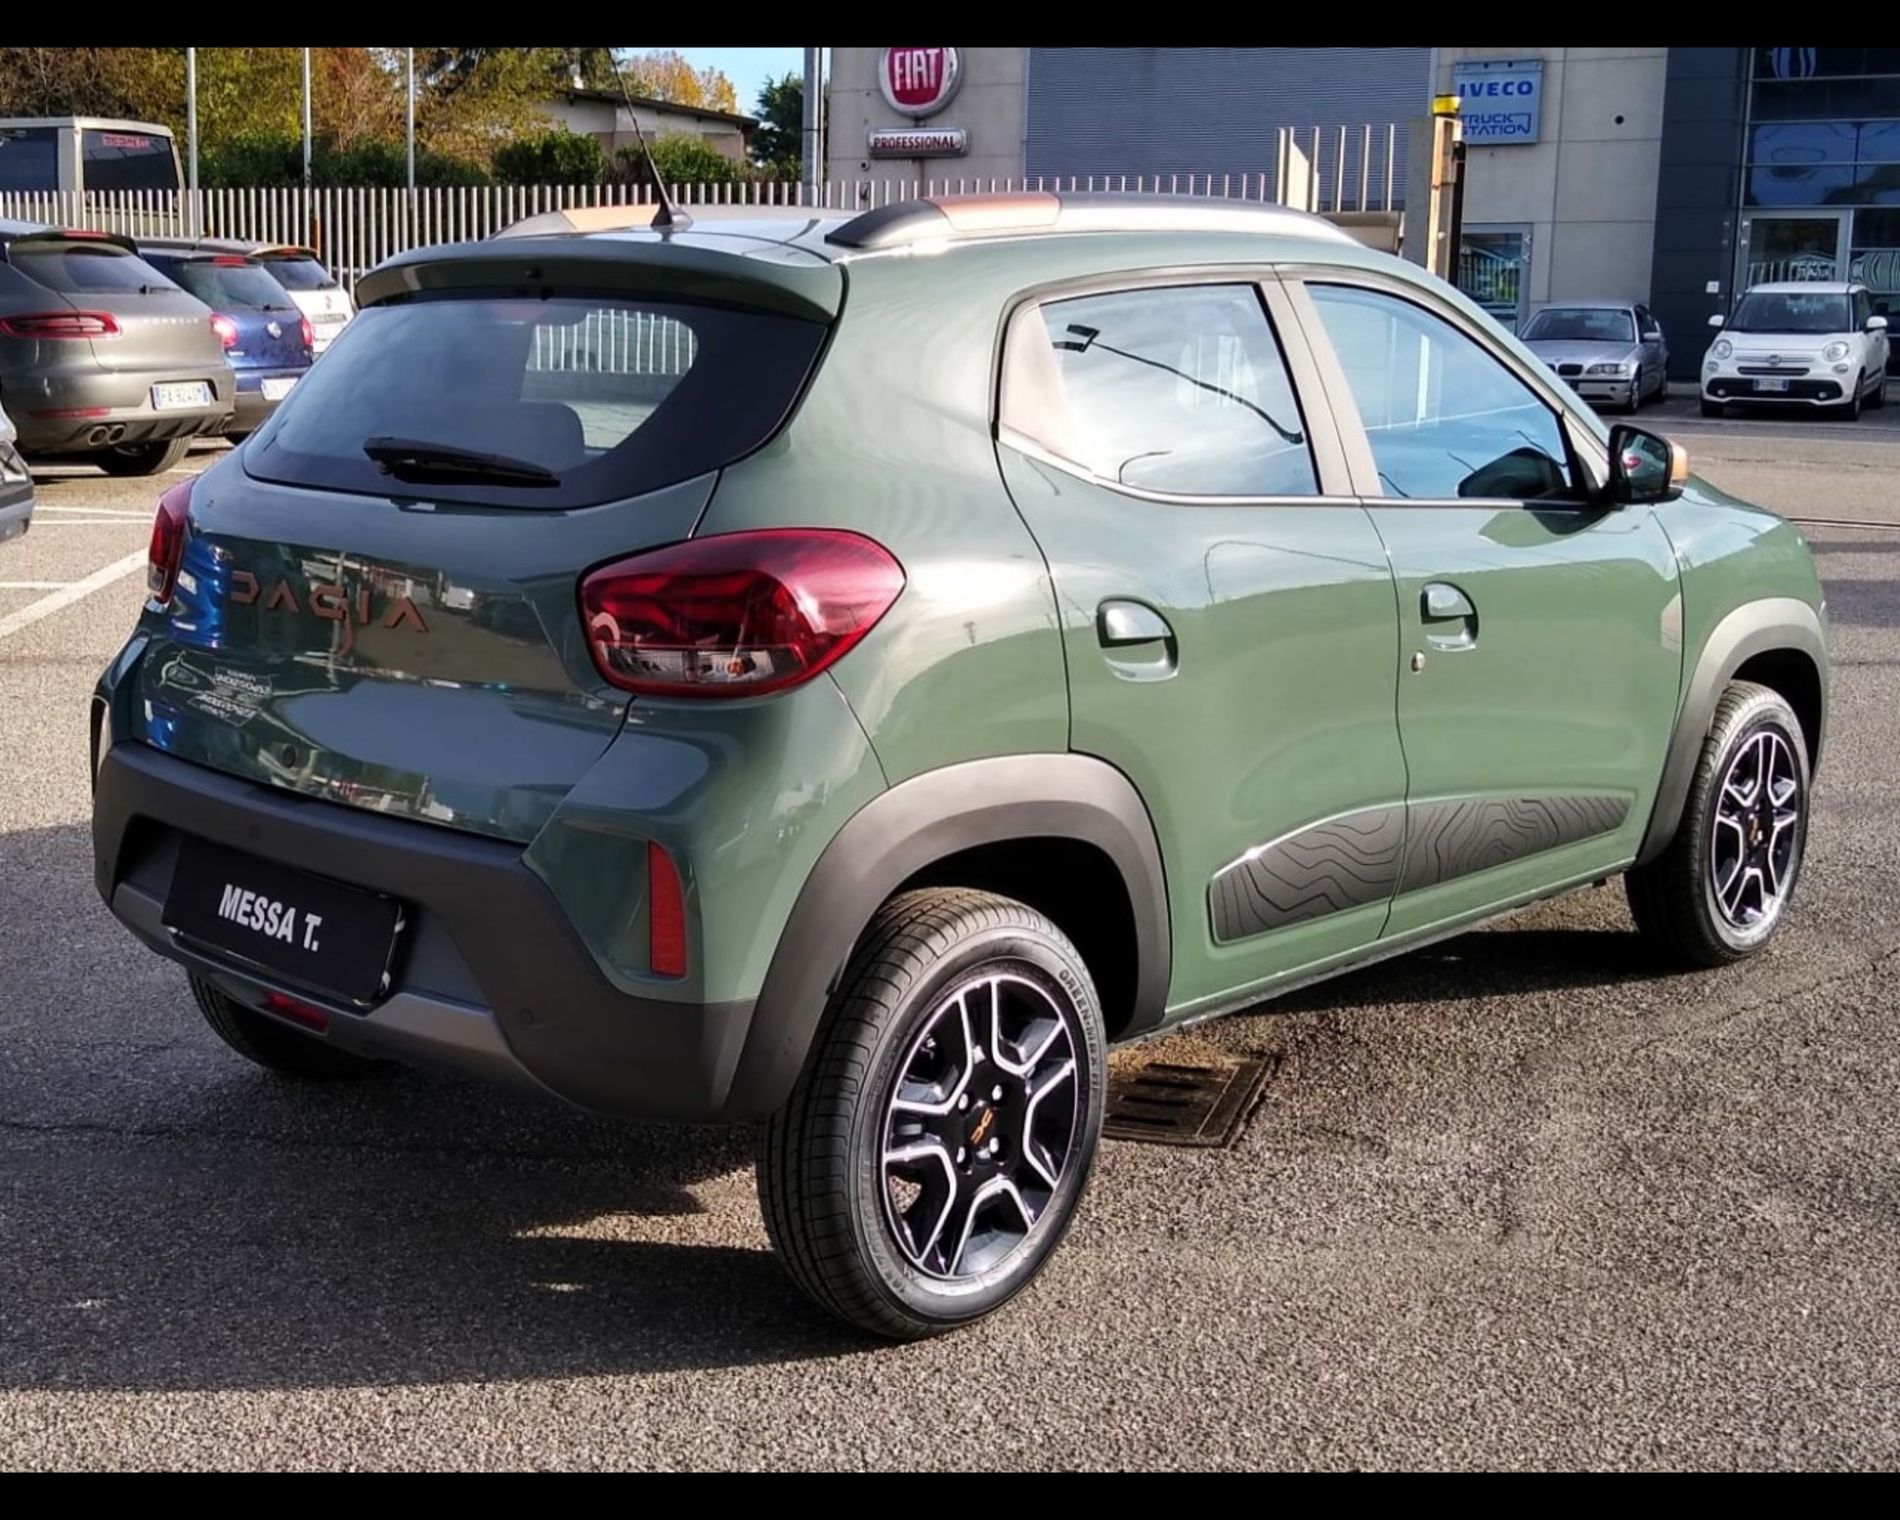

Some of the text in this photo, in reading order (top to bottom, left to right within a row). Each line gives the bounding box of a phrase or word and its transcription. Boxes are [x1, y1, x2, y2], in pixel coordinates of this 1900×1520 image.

[894, 48, 940, 91] FIAT
[1459, 81, 1533, 97] IVECO
[1460, 112, 1513, 125] TRUCK
[873, 135, 955, 150] PROFESSIONAL
[231, 570, 430, 634] DACIA
[218, 883, 323, 952] MESSA T.
